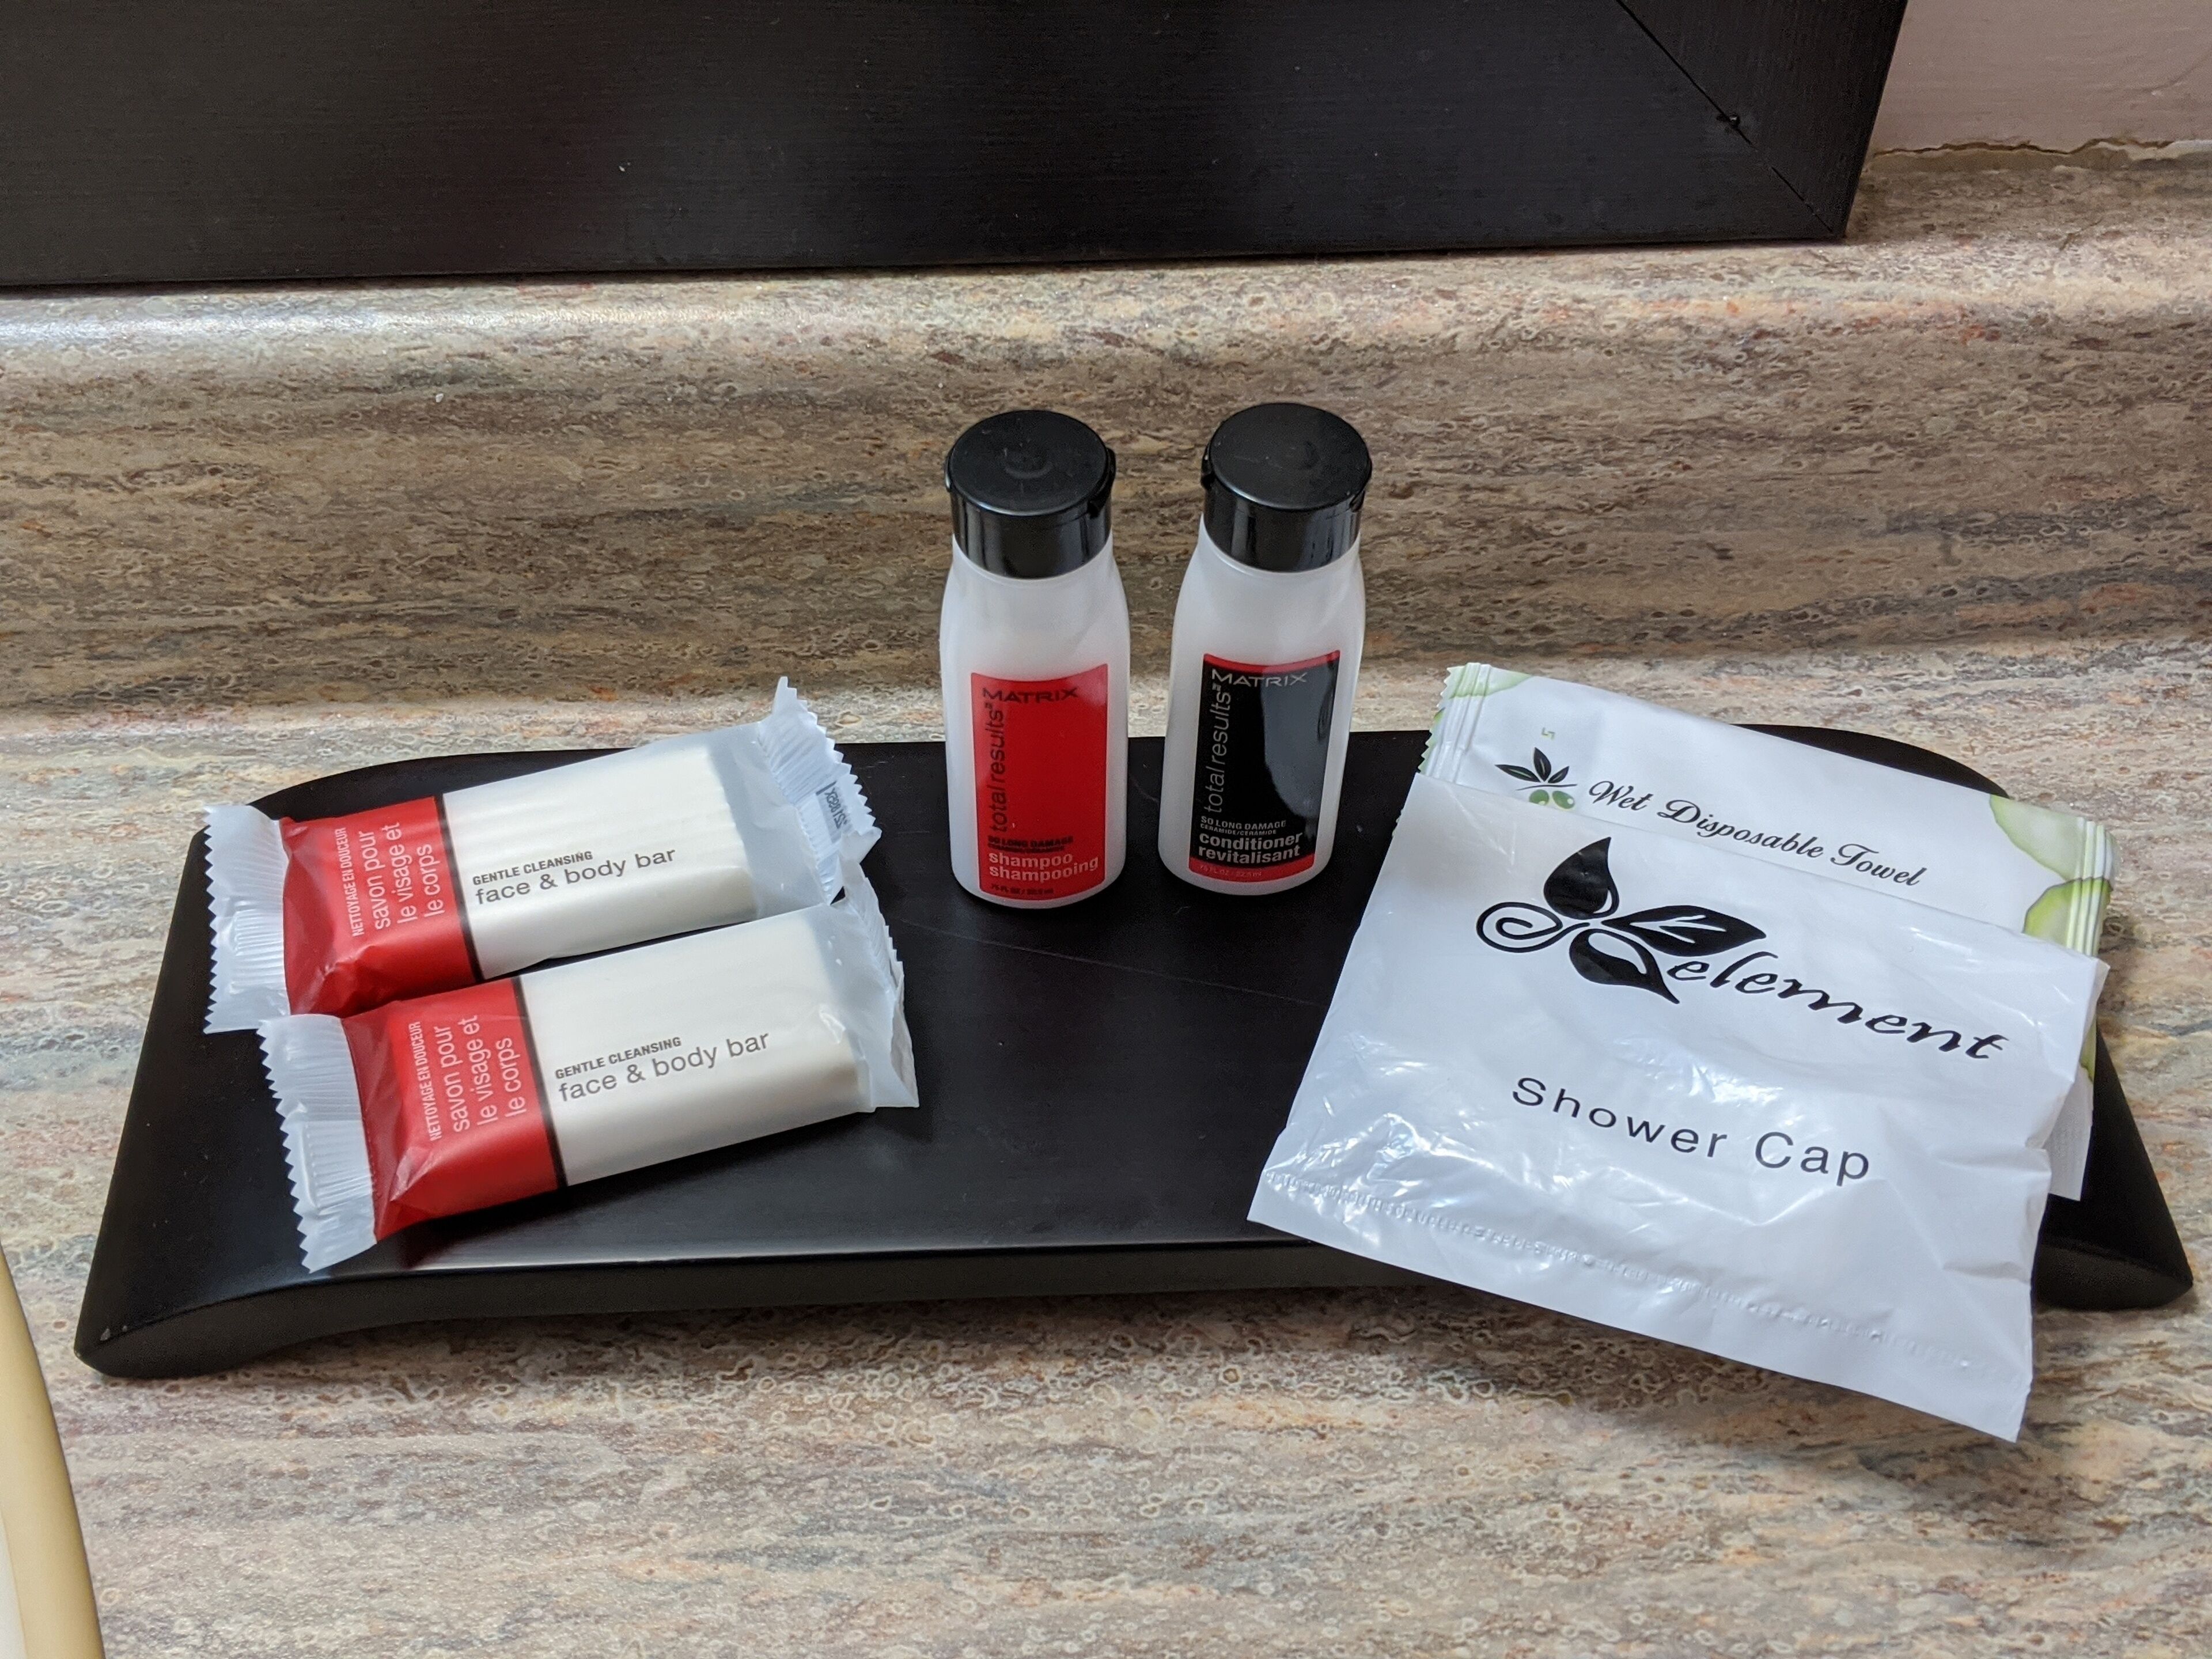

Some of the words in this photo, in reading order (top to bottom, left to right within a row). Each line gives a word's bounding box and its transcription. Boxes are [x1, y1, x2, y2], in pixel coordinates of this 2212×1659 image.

[983, 687, 1078, 704] MATRIX
[1211, 668, 1308, 687] MATRIX
[987, 784, 1007, 832] total
[1203, 766, 1225, 813] total
[381, 822, 402, 840] et
[1199, 832, 1303, 851] conditioner
[1200, 816, 1214, 825] SO
[1215, 820, 1242, 830] LONG
[1244, 820, 1286, 831] DAMAGE
[1588, 780, 1654, 812] Wet
[1657, 798, 1824, 858] Disposable
[1830, 843, 1928, 887] Towel
[335, 827, 353, 869] DOUCEUR
[358, 831, 385, 872] pour
[472, 866, 521, 886] GENTLE
[523, 850, 593, 874] CLEANSING
[988, 852, 1073, 870] shampoo
[1198, 845, 1300, 864] revitalisant
[342, 869, 355, 882] EN
[389, 844, 413, 902] visage
[416, 844, 440, 895] corps
[475, 882, 531, 904] face
[539, 873, 559, 891] &
[565, 860, 626, 885] body
[635, 849, 676, 868] bar
[989, 857, 1099, 883] shampooing
[343, 881, 365, 937] NETTOYAGE
[366, 875, 391, 930] savon
[397, 905, 418, 923] le
[423, 899, 445, 917] le
[457, 1014, 480, 1035] et
[1666, 951, 2009, 1059] element
[408, 1021, 428, 1066] DOUCEUR
[433, 1026, 463, 1068] pour
[495, 1037, 521, 1092] corps
[555, 1057, 605, 1080] GENTLE
[608, 1036, 681, 1065] CLEANSING
[416, 1066, 431, 1081] EN
[467, 1038, 494, 1102] visage
[558, 1074, 618, 1102] face
[626, 1064, 646, 1084] &
[652, 1046, 717, 1077] body
[726, 1033, 769, 1058] bar
[419, 1081, 442, 1141] NETTOYAGE
[444, 1071, 471, 1132] savon
[477, 1104, 498, 1126] le
[504, 1096, 527, 1118] le
[1512, 1077, 1728, 1158] Shower
[1755, 1131, 1869, 1187] Cap
